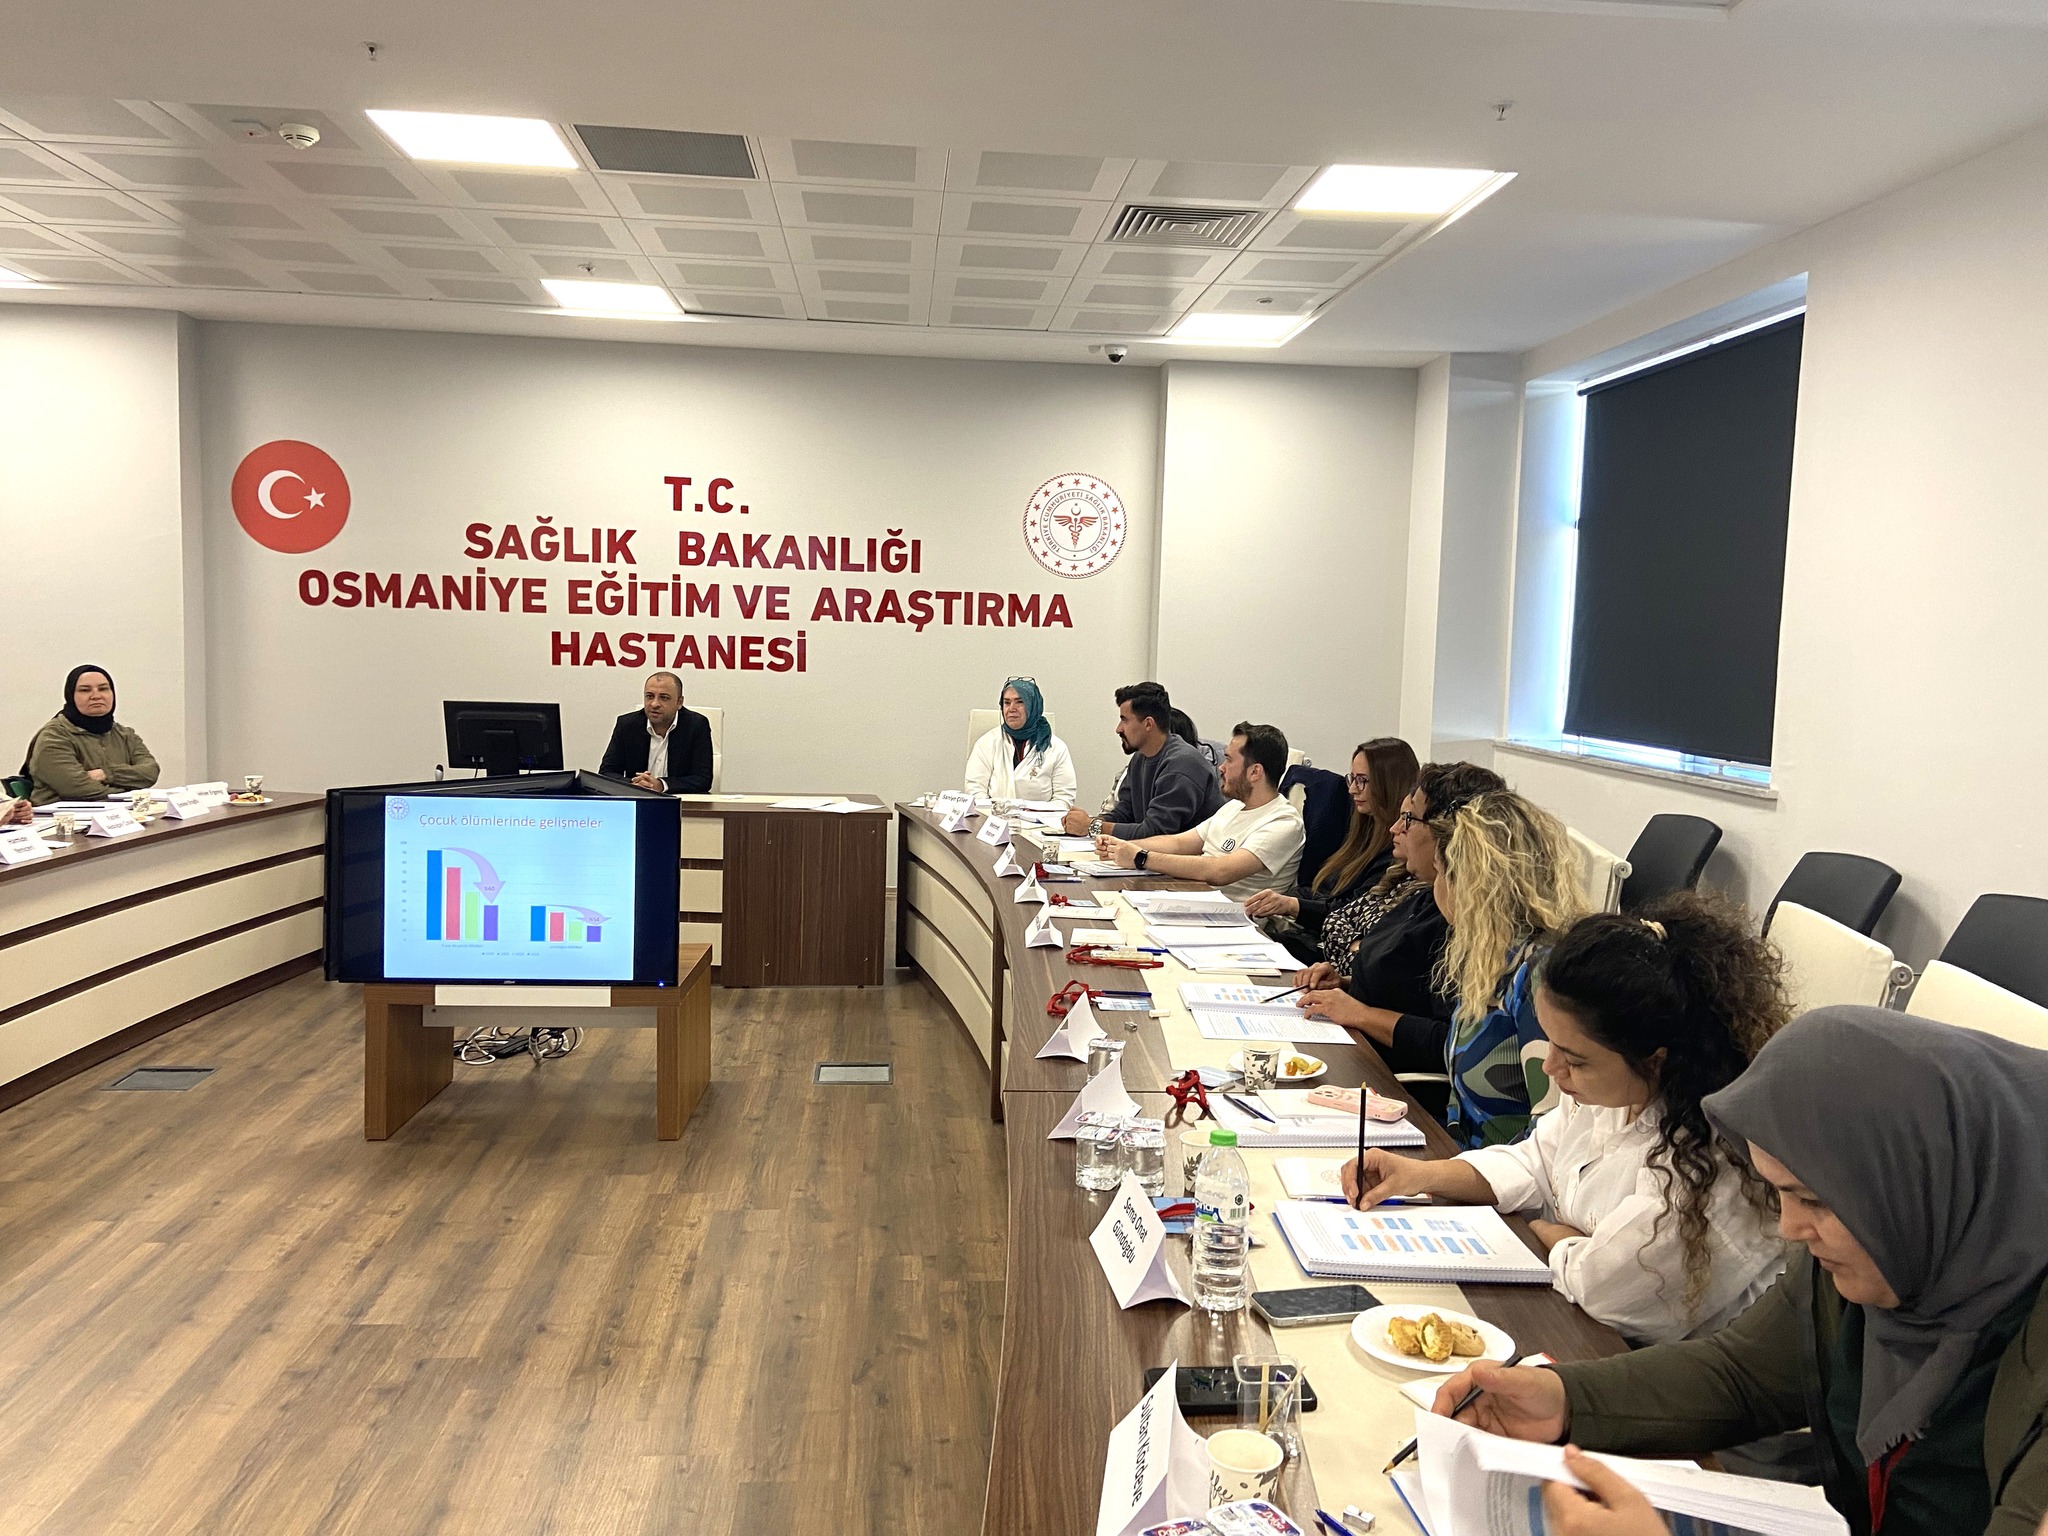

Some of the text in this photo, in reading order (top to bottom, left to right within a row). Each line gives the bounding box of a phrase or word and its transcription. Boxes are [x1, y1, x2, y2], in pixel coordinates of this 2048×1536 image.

[664, 476, 749, 514] T.C.
[464, 516, 921, 575] SAĞLIK BAKANLIĞI
[298, 567, 1073, 632] OSMANİYE EĞİTİM VE ARAŞTIRMA
[551, 631, 807, 673] HASTANESİ
[419, 814, 604, 829] Çocuk ölümlerinde gelişmeler
[1112, 1219, 1136, 1264] Gündoğdu
[1124, 1196, 1148, 1243] Sema Onat
[1132, 1394, 1154, 1508] Sultan Kördeve
